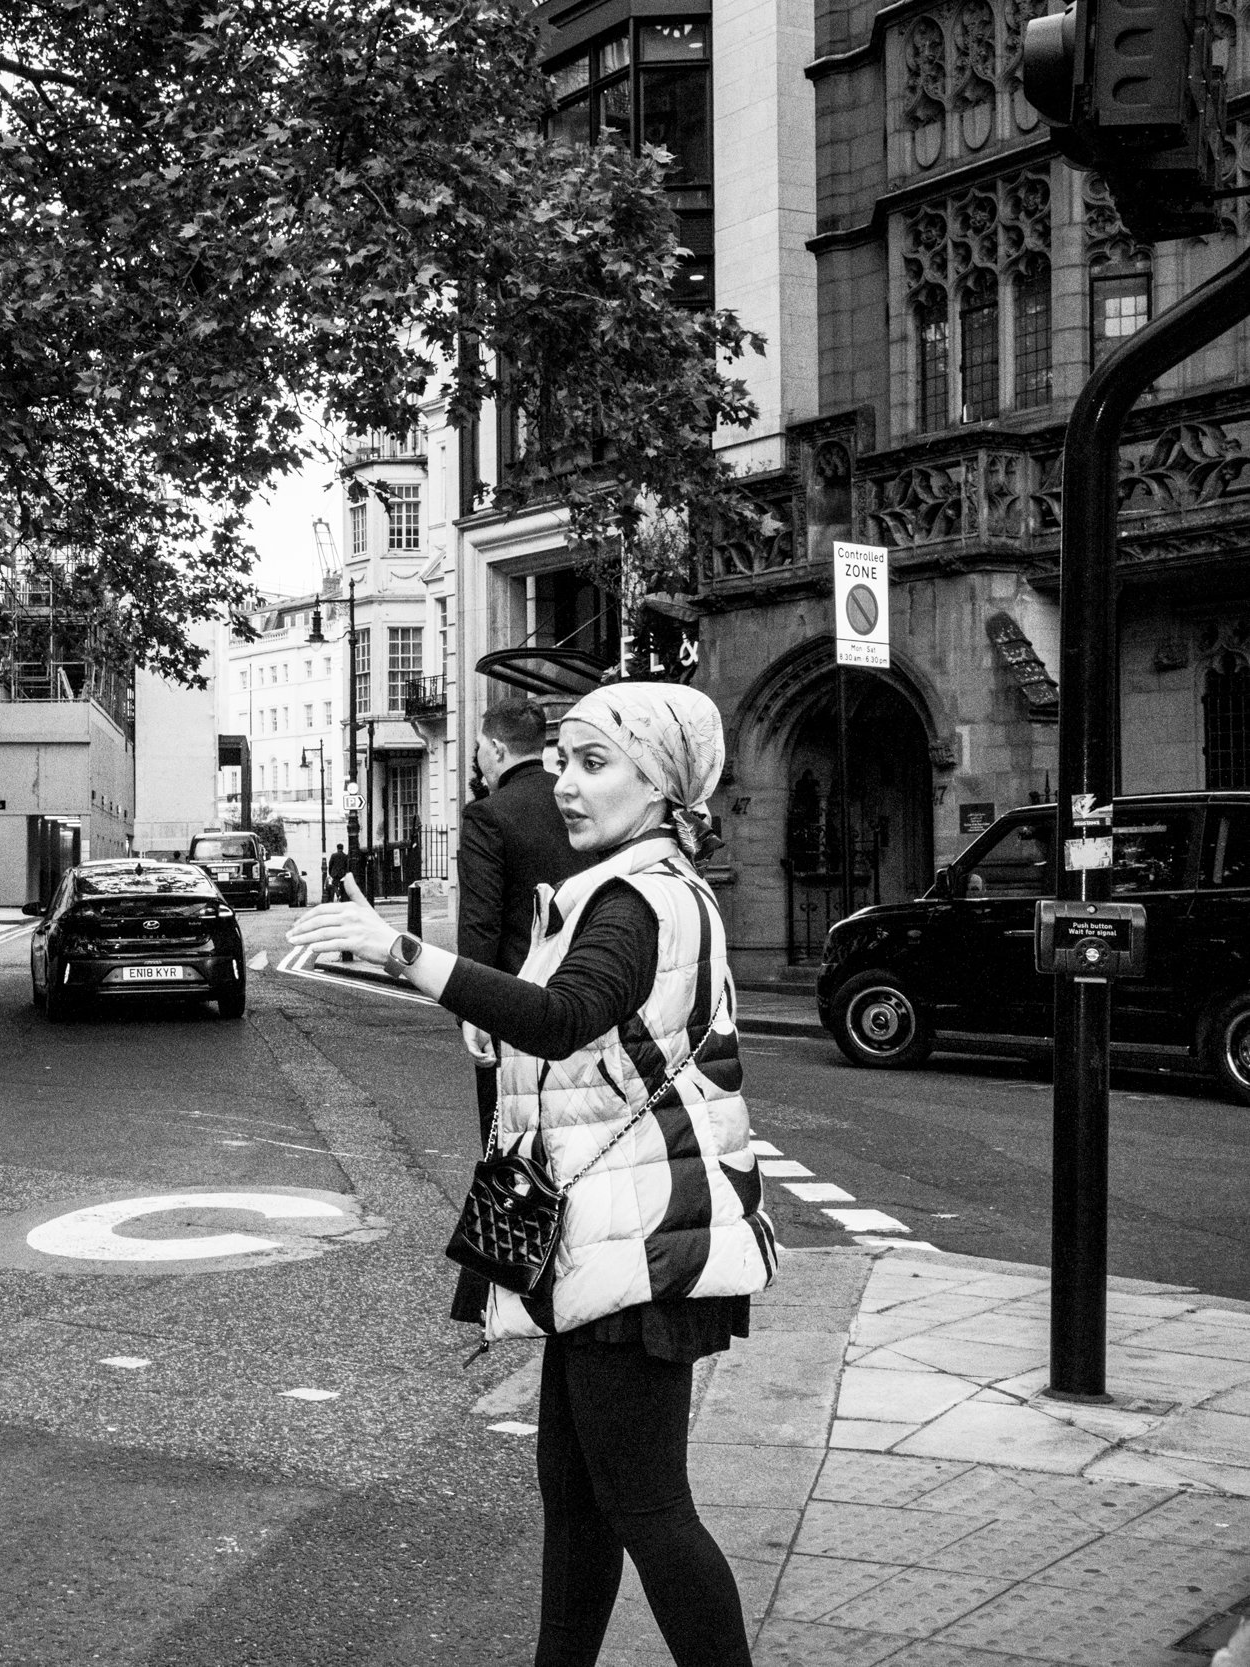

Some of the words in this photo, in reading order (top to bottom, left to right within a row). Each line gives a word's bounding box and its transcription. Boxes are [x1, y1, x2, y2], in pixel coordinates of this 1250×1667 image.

[837, 547, 884, 563] Controlled
[845, 563, 877, 580] ZONE
[866, 645, 876, 653] Sat
[731, 797, 751, 814] 47
[1097, 929, 1117, 937] signal
[129, 968, 153, 978] EN18
[156, 967, 177, 977] KYR
[26, 1192, 343, 1261] C
